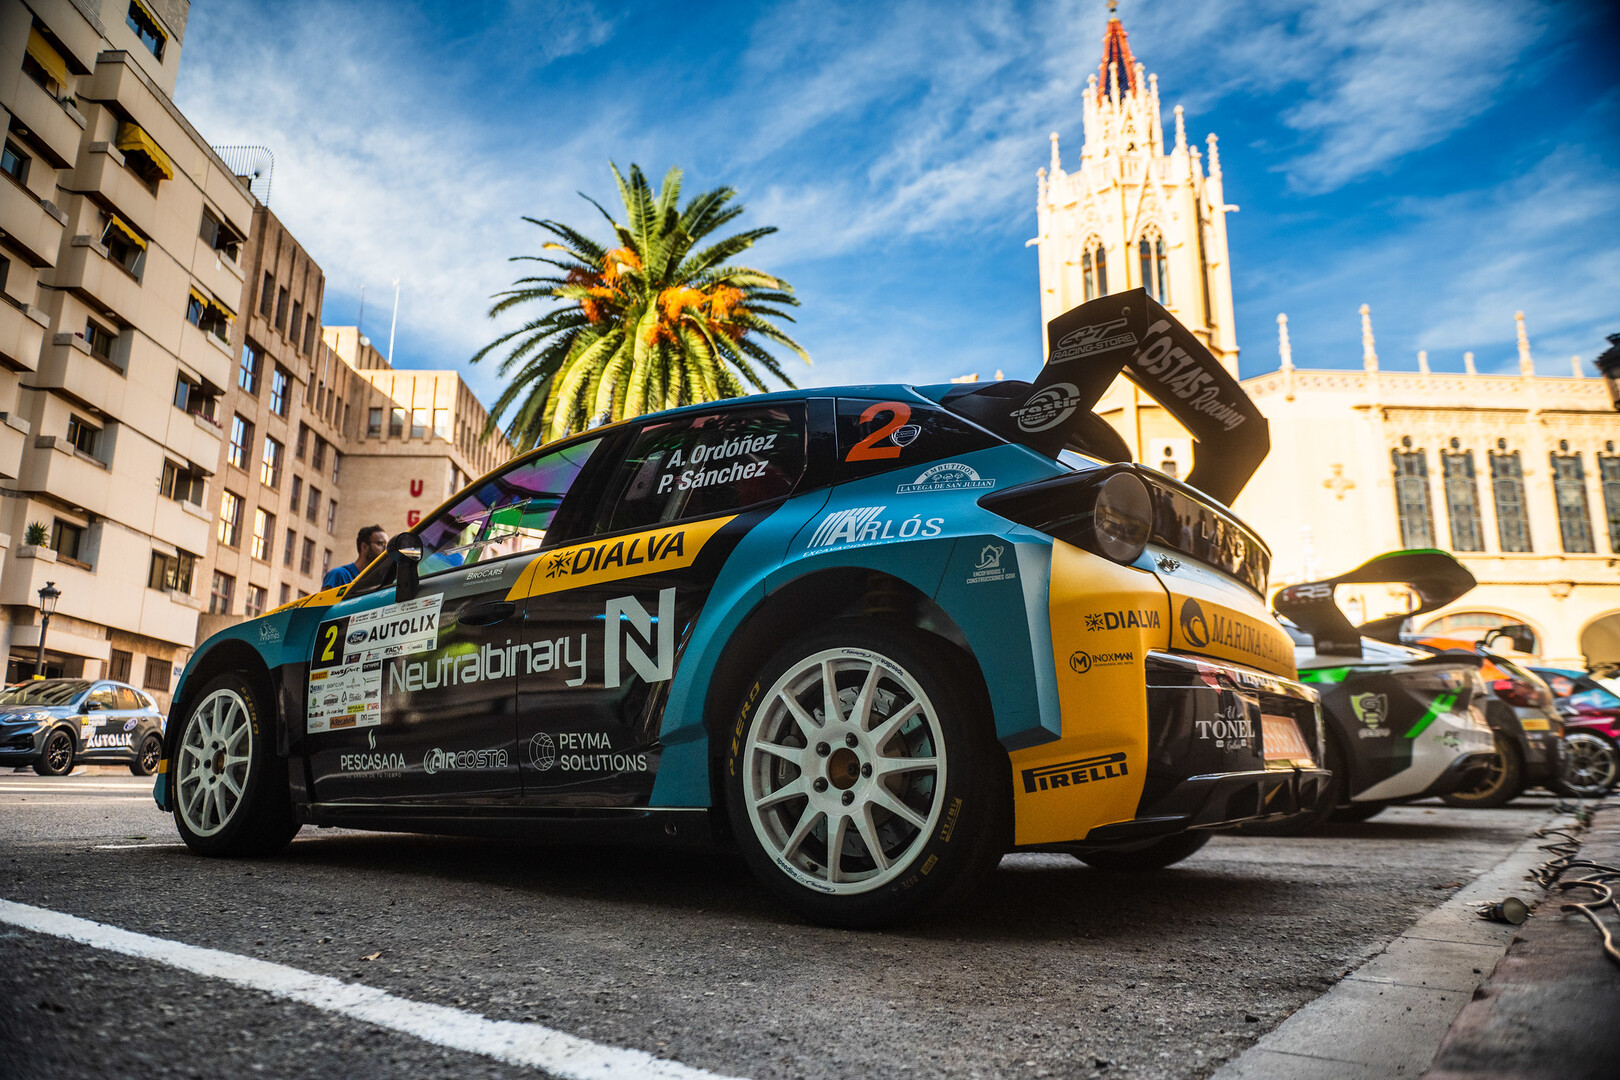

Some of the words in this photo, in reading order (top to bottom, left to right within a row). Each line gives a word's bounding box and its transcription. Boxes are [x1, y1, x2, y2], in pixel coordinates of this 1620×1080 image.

[1052, 334, 1134, 361] RACING-STORE
[1131, 319, 1215, 399] COSTAS
[1188, 386, 1247, 432] Racing
[845, 401, 912, 463] 2
[666, 451, 686, 469] A.
[690, 433, 778, 465] Ordóñez
[656, 473, 673, 495] P.
[678, 459, 770, 491] Sánchez
[911, 483, 933, 491] VEGA
[934, 482, 946, 490] DE
[946, 481, 961, 489] SAN
[923, 463, 975, 478] EMBUTIDOS
[818, 511, 945, 546] ARLÓS
[571, 531, 686, 575] DIALVA
[367, 613, 437, 643] AUTOLIX
[1103, 610, 1161, 630] DIALVA
[321, 625, 338, 662] 2
[604, 587, 677, 689] N
[388, 633, 588, 695] Neutralbinary
[1092, 652, 1134, 663] INOXMAN
[731, 681, 760, 757] ZERO
[1195, 720, 1256, 740] TONEL
[86, 732, 133, 748] AUTOLIX
[559, 732, 612, 750] PEYMA
[560, 754, 648, 772] SOLUTIONS
[1020, 751, 1129, 794] PIRELLI
